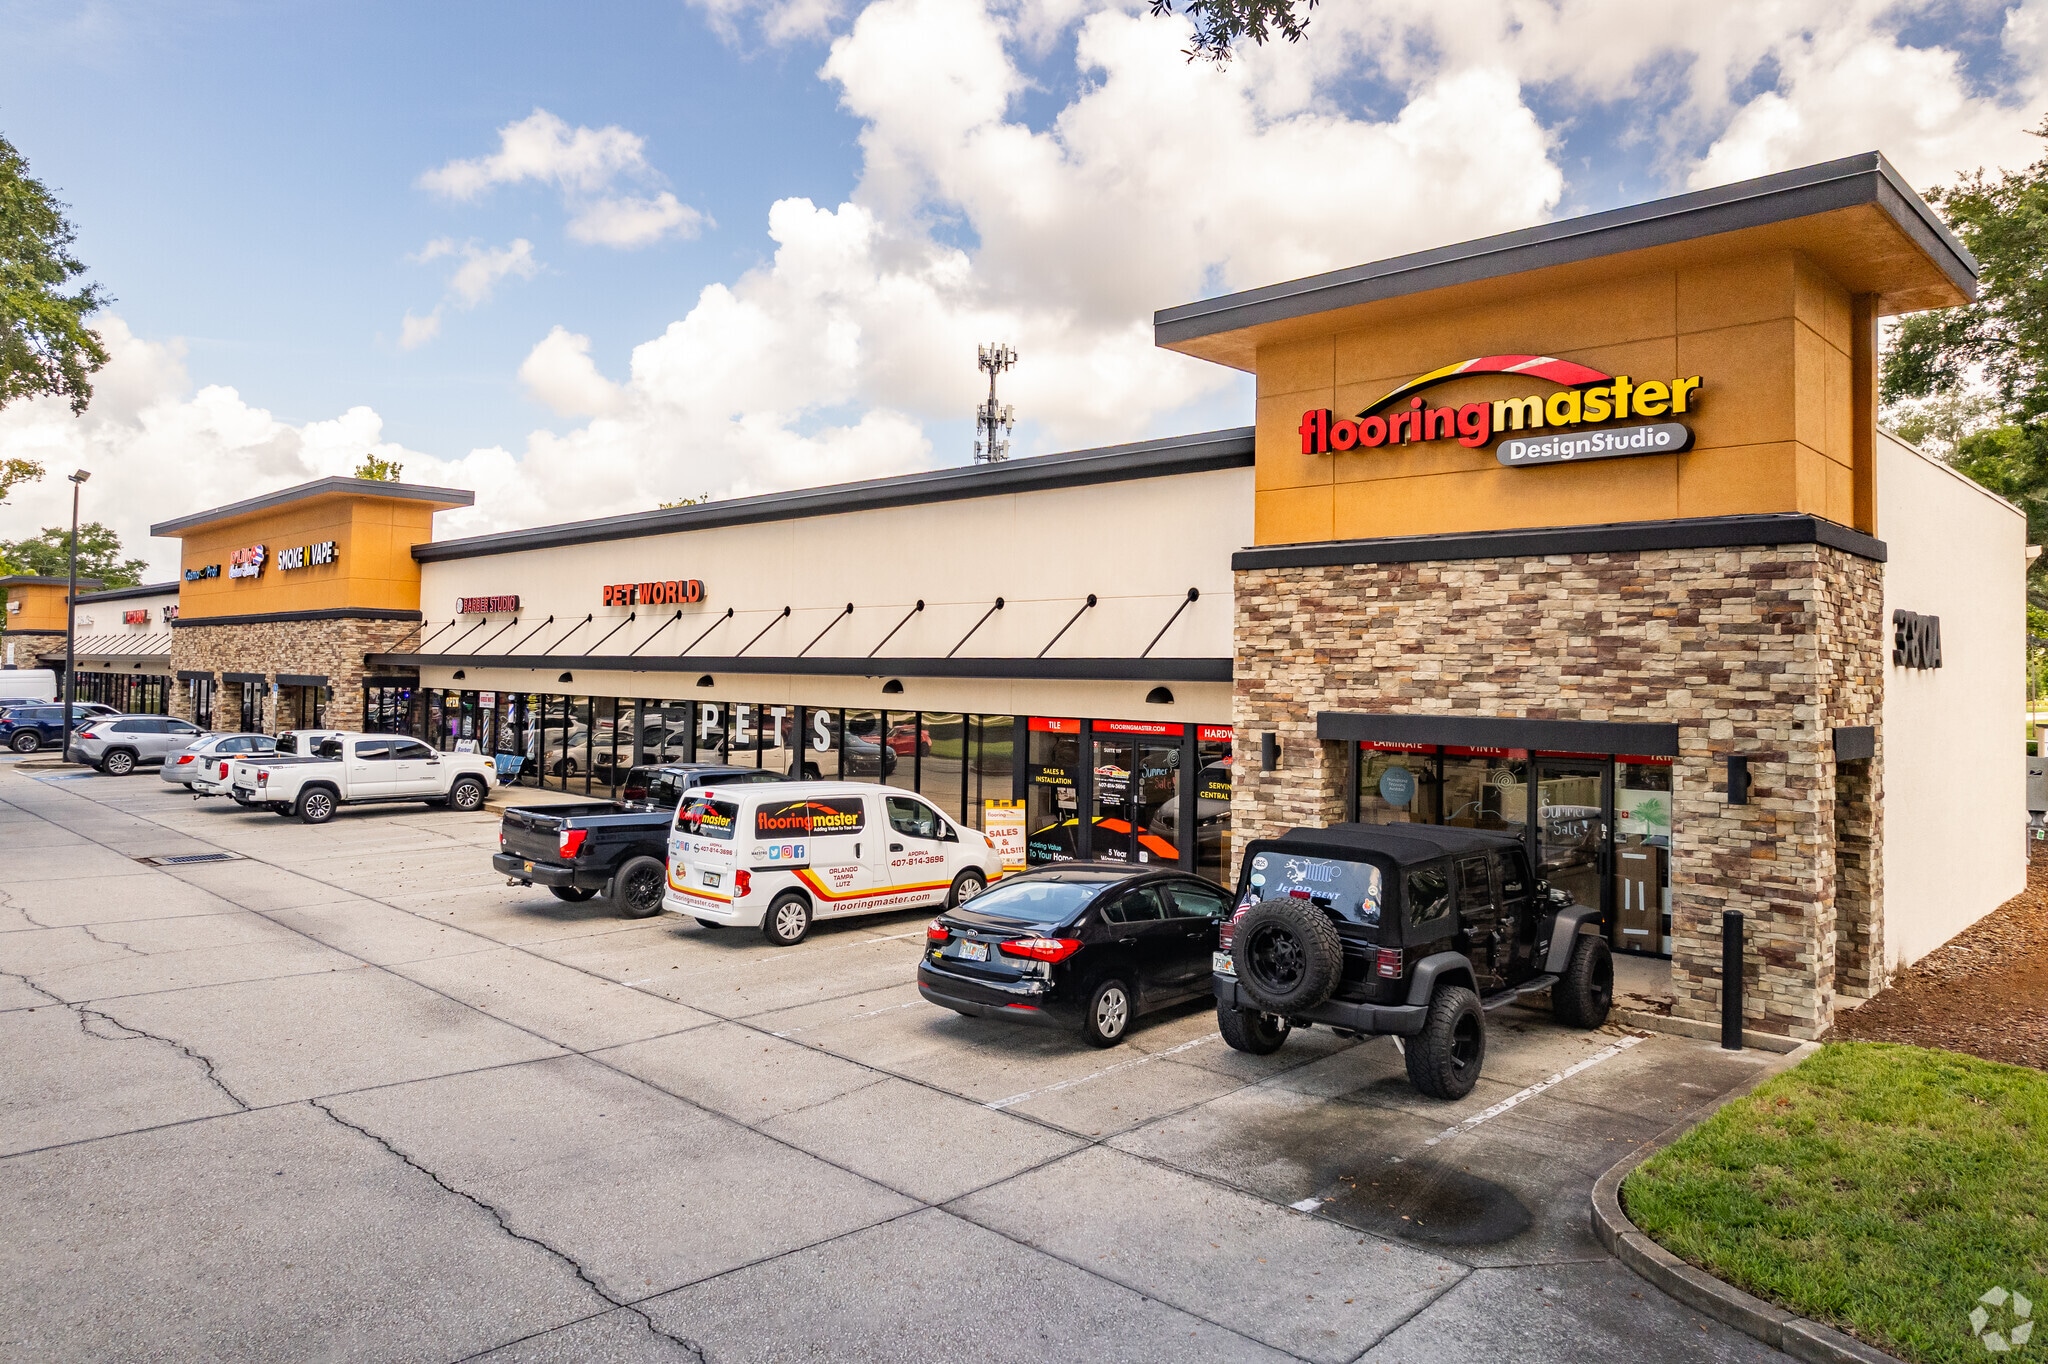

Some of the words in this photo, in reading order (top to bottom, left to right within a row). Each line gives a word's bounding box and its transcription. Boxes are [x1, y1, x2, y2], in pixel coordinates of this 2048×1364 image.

[1299, 375, 1702, 455] flooringmaster
[1510, 428, 1671, 460] DesignStudio
[278, 547, 303, 570] SMOKE
[304, 546, 310, 566] N
[311, 541, 333, 564] VAPE
[603, 585, 633, 606] PET
[639, 580, 700, 604] WORLD
[463, 598, 489, 614] BARBER
[490, 596, 516, 612] STUDIO
[701, 703, 831, 752] PETS
[1049, 721, 1061, 729] TILE
[1110, 723, 1166, 732] FLOORINGMASTER.COM
[1043, 767, 1059, 775] SALES
[1036, 776, 1072, 785] INSTALLATION
[1200, 791, 1229, 800] CENTRAL
[758, 812, 858, 831] flooringmaster
[989, 828, 1018, 837] SALES
[1029, 841, 1047, 850] Adding
[1048, 843, 1061, 851] Value
[1029, 849, 1036, 858] To
[1037, 850, 1052, 860] Your
[1108, 848, 1113, 856] 5
[1113, 849, 1127, 857] Year
[891, 855, 944, 867] 407-814-3696
[829, 866, 858, 875] ORLANDO
[673, 893, 720, 909] flooringmaster.com
[833, 893, 930, 912] flooringmaster.com
